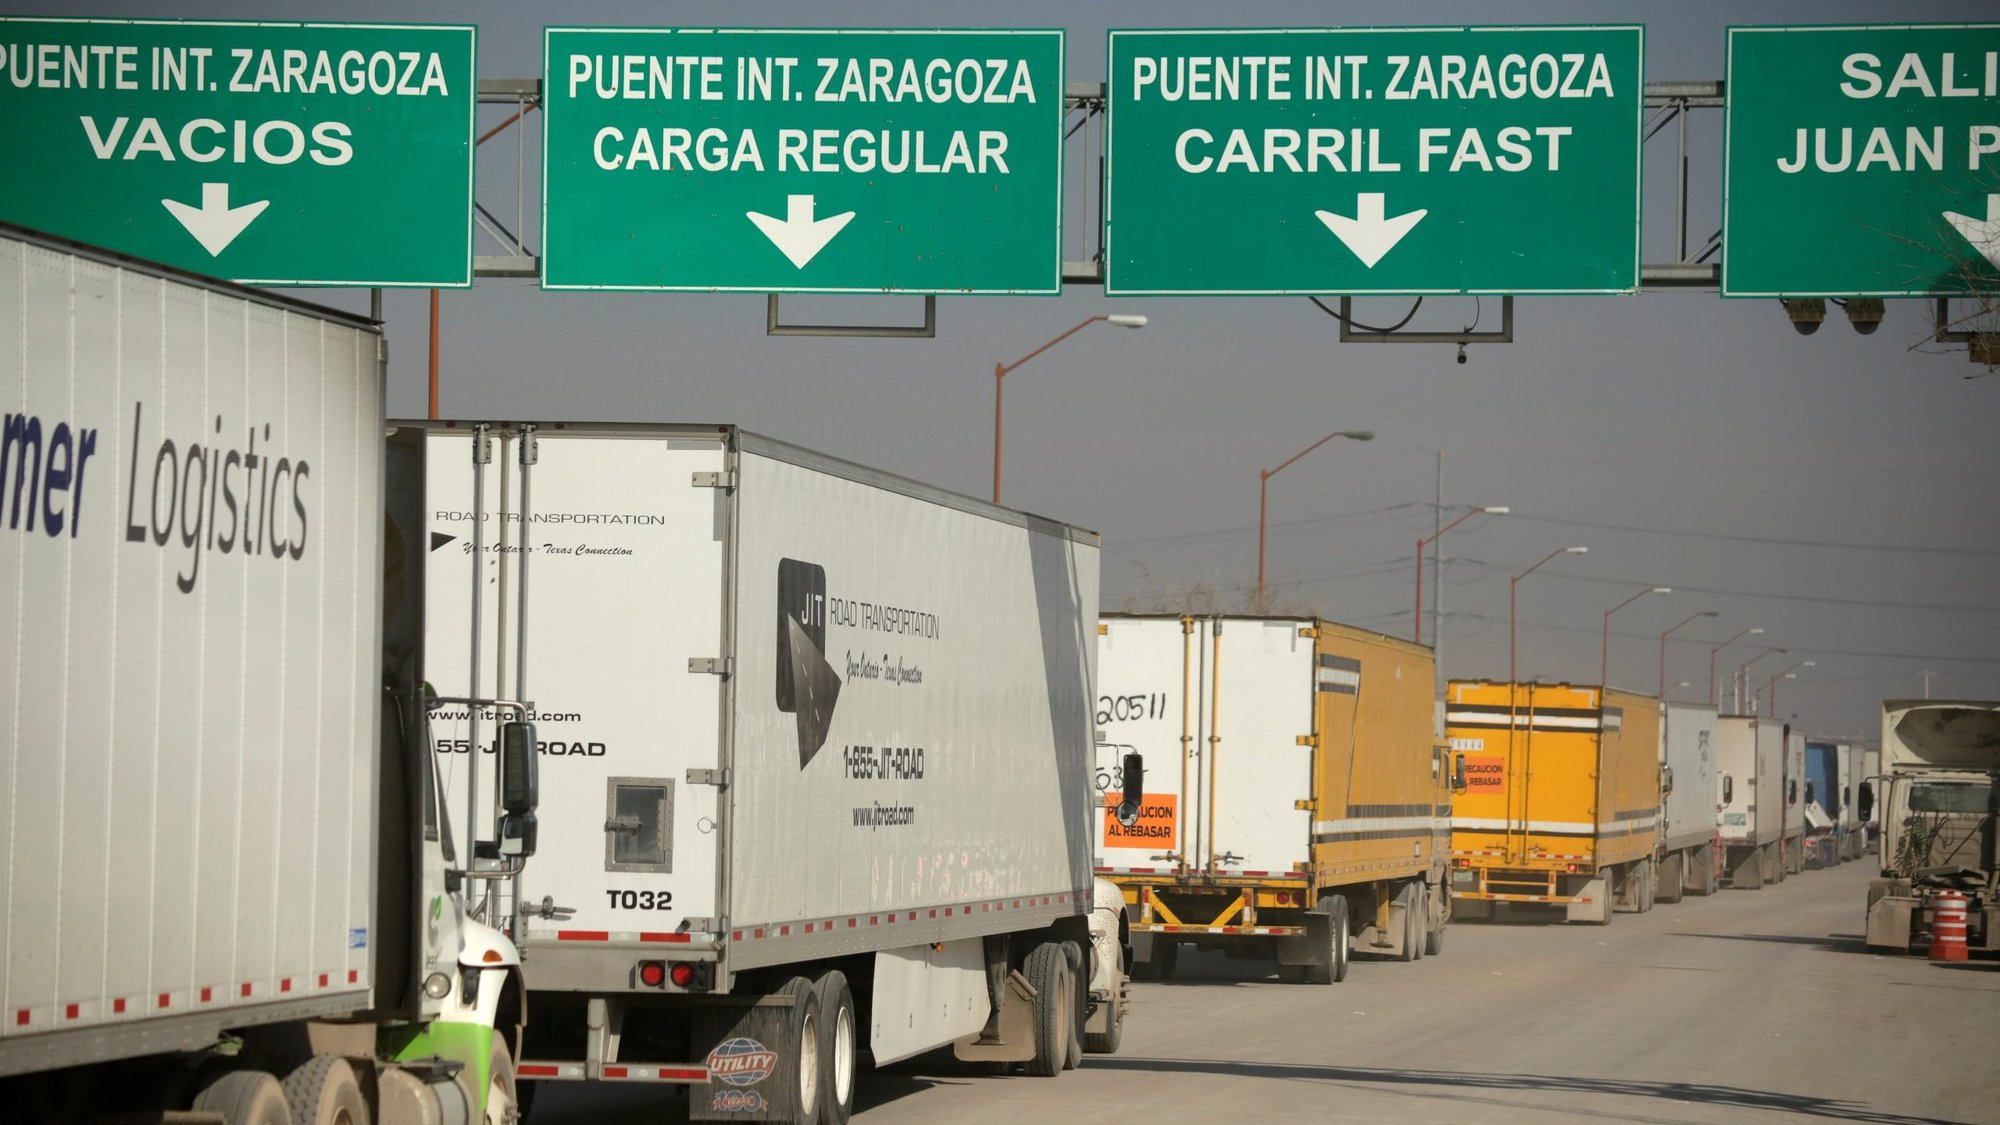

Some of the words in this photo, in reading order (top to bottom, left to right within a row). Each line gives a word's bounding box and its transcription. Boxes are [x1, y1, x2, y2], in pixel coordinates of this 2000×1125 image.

[152, 46, 219, 92] INT.
[228, 48, 449, 97] ZARAGOZA
[569, 54, 724, 100] PUENTE
[737, 56, 803, 102] INT.
[815, 57, 1037, 104] ZARAGOZA
[1133, 56, 1291, 101] PUENTE
[1305, 55, 1372, 100] INT.
[1385, 53, 1615, 100] ZARAGOZA
[1840, 51, 1998, 99] SALI
[80, 116, 354, 166] VACIOS
[593, 126, 765, 172] CARGA
[778, 128, 1010, 174] REGULAR
[1175, 128, 1401, 174] CARRIL
[1418, 126, 1573, 173] FAST
[1776, 126, 1944, 174] JUAN
[126, 401, 310, 594] Logistics
[492, 541, 533, 554] Ontaro
[543, 543, 573, 555] Texas
[575, 544, 633, 556] Connection
[801, 592, 823, 627] JIT
[830, 597, 857, 628] ROAD
[860, 602, 940, 640] TRANSPORTATION
[1096, 692, 1166, 725] 20511
[843, 744, 924, 780] 1-855-JIT-ROAD
[853, 800, 915, 831] www.jitroad.com
[1108, 824, 1122, 837] AL
[1123, 825, 1172, 839] REBASAR
[606, 889, 673, 911] T032
[711, 1054, 772, 1073] UTILITY
